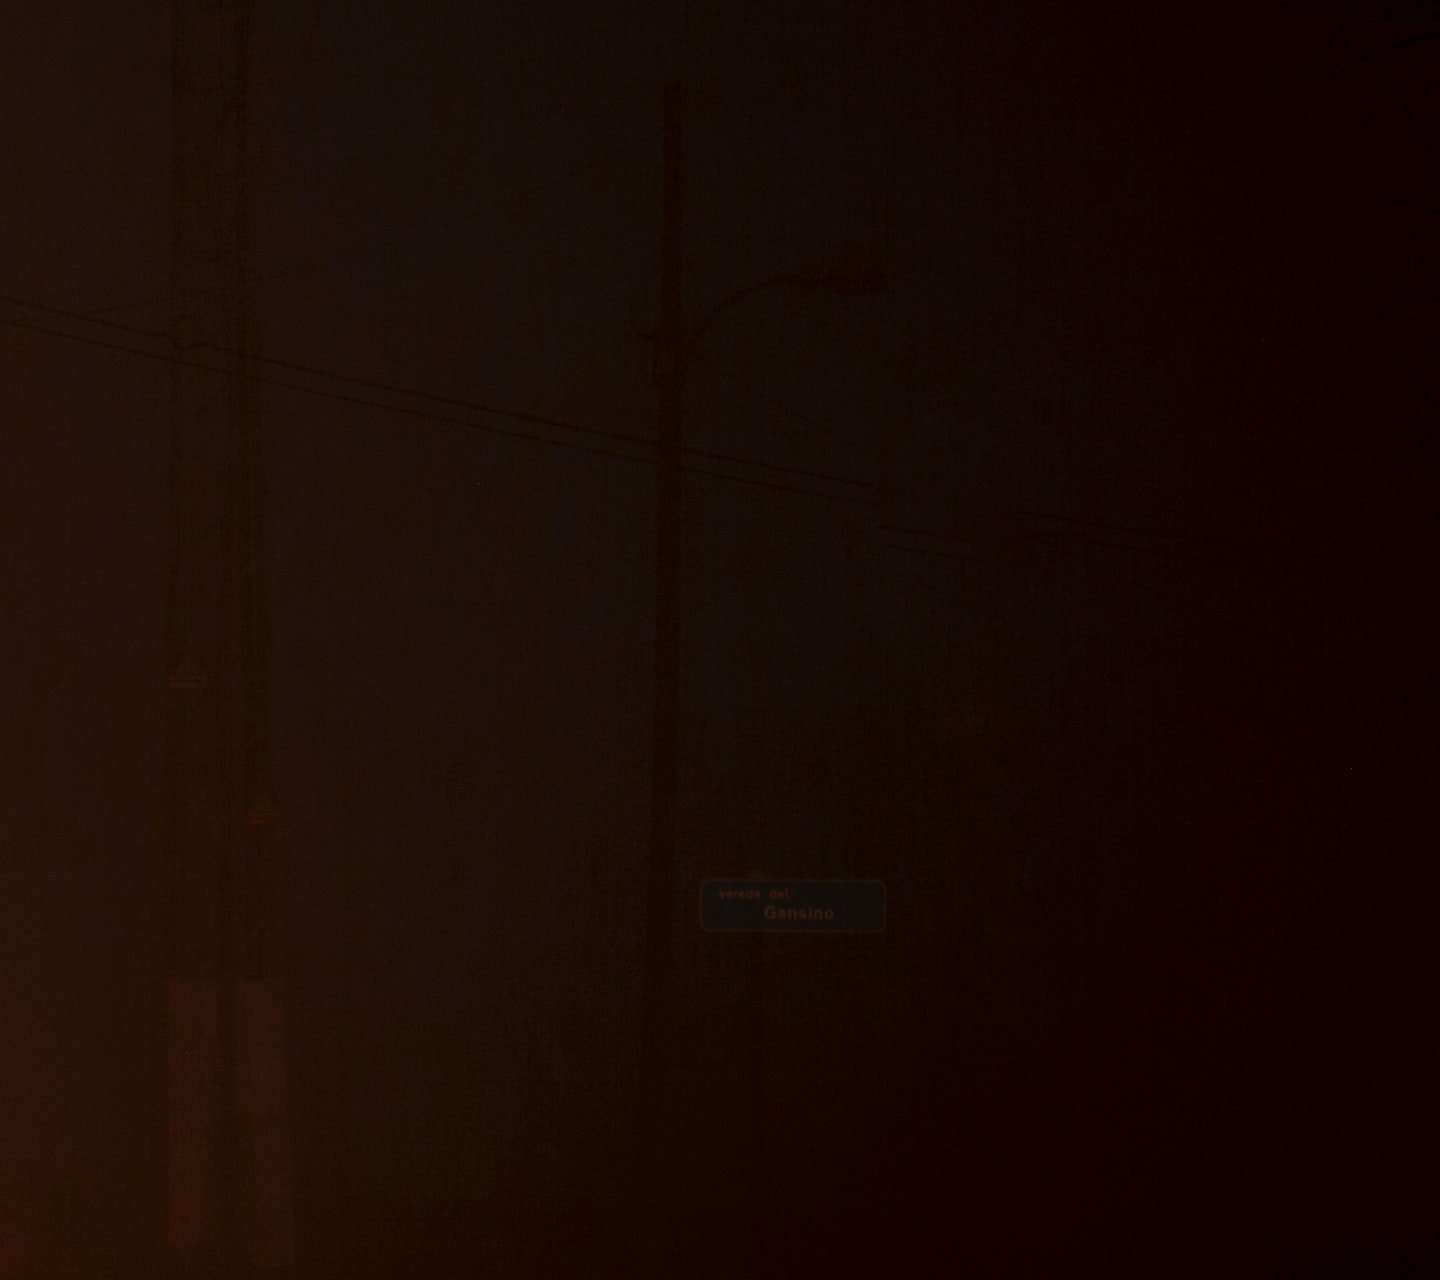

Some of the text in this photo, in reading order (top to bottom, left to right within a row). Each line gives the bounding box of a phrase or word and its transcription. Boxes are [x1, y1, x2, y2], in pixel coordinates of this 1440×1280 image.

[718, 888, 789, 900] vereda del
[763, 904, 835, 920] Gansino
